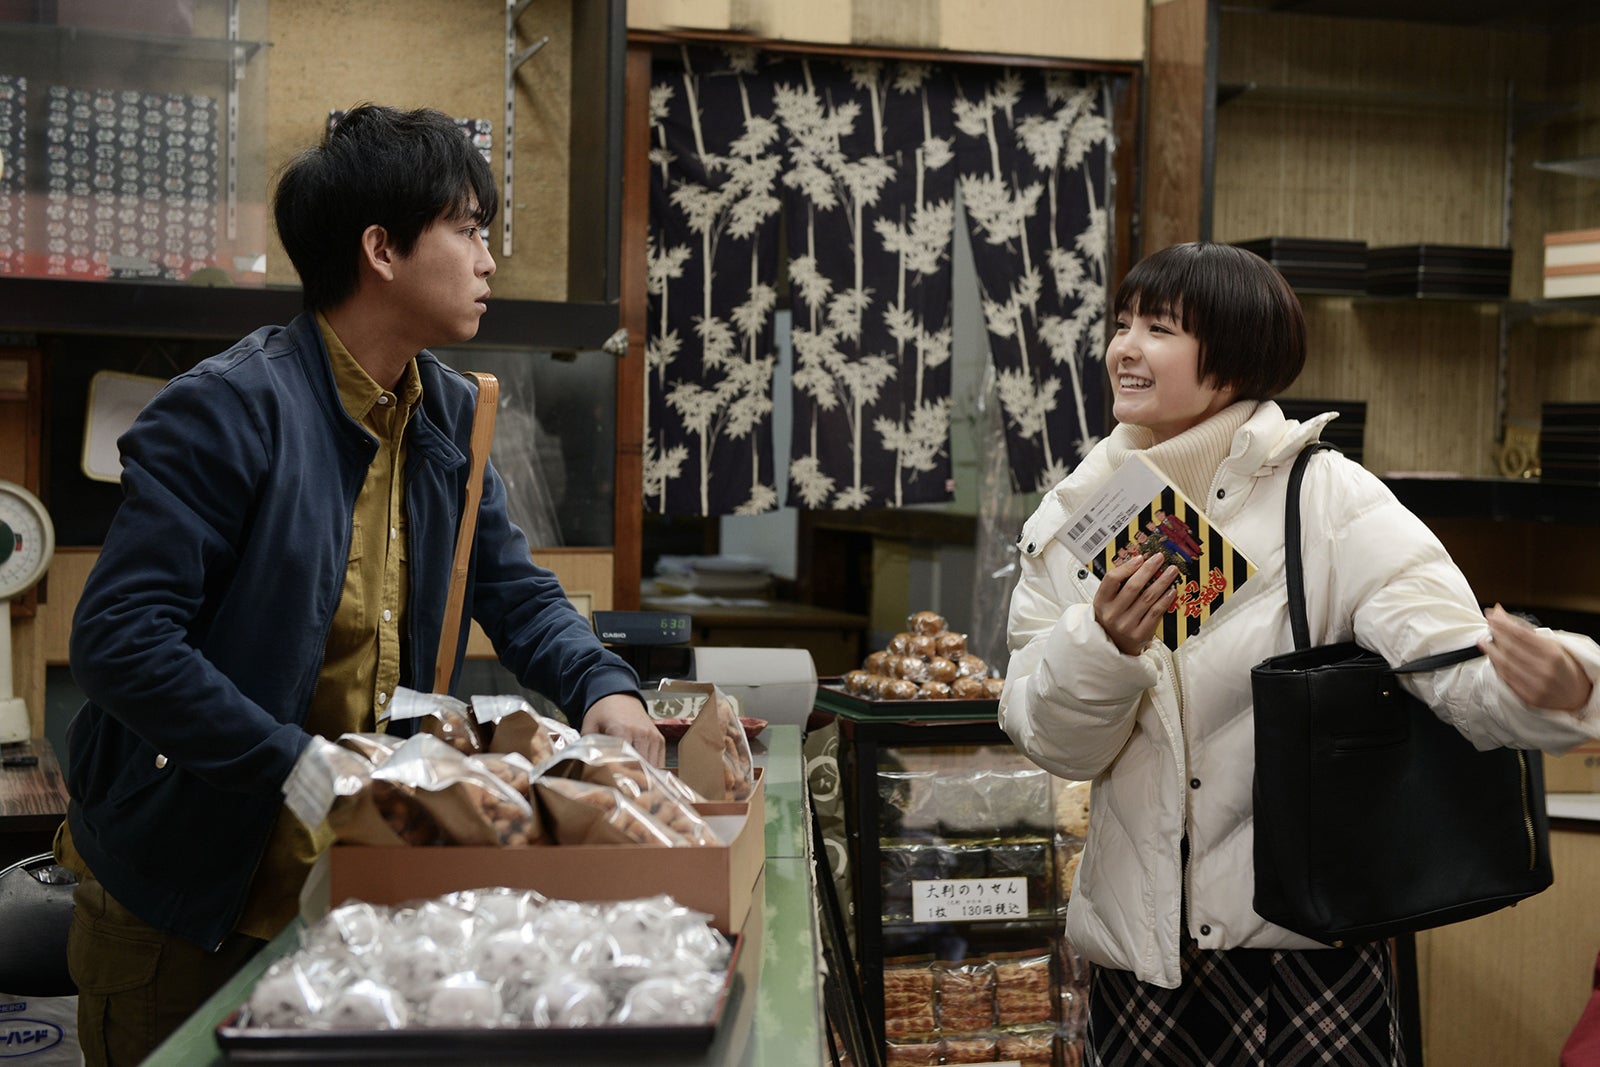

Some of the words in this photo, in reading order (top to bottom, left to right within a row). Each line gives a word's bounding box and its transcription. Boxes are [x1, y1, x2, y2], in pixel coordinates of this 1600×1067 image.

[661, 619, 685, 629] 630
[928, 906, 947, 918] 1枚
[962, 902, 1020, 916] 130円税込
